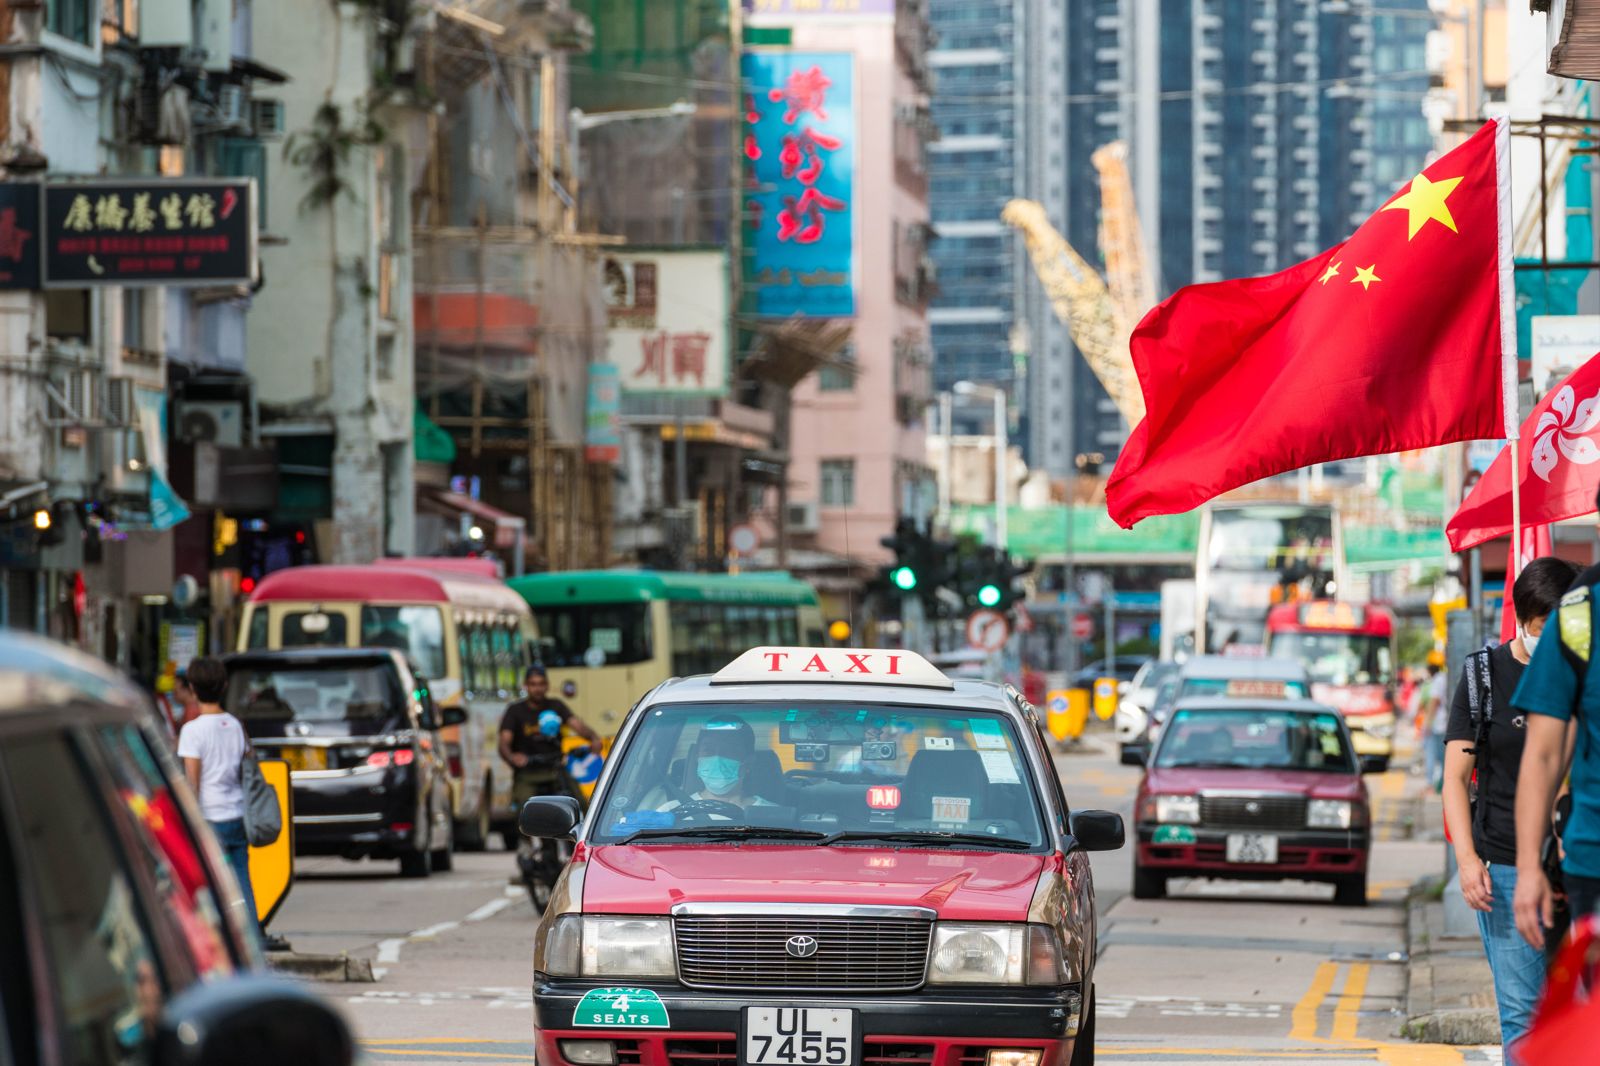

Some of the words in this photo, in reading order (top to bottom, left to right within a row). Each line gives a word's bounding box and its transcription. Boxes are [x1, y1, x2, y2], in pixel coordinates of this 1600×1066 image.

[763, 653, 902, 675] TAXI
[870, 788, 898, 806] TAXI
[935, 803, 967, 818] TAXI
[611, 994, 630, 1012] 4
[593, 1014, 650, 1024] SEATS
[776, 1008, 822, 1036] UL
[752, 1035, 847, 1064] 7455
